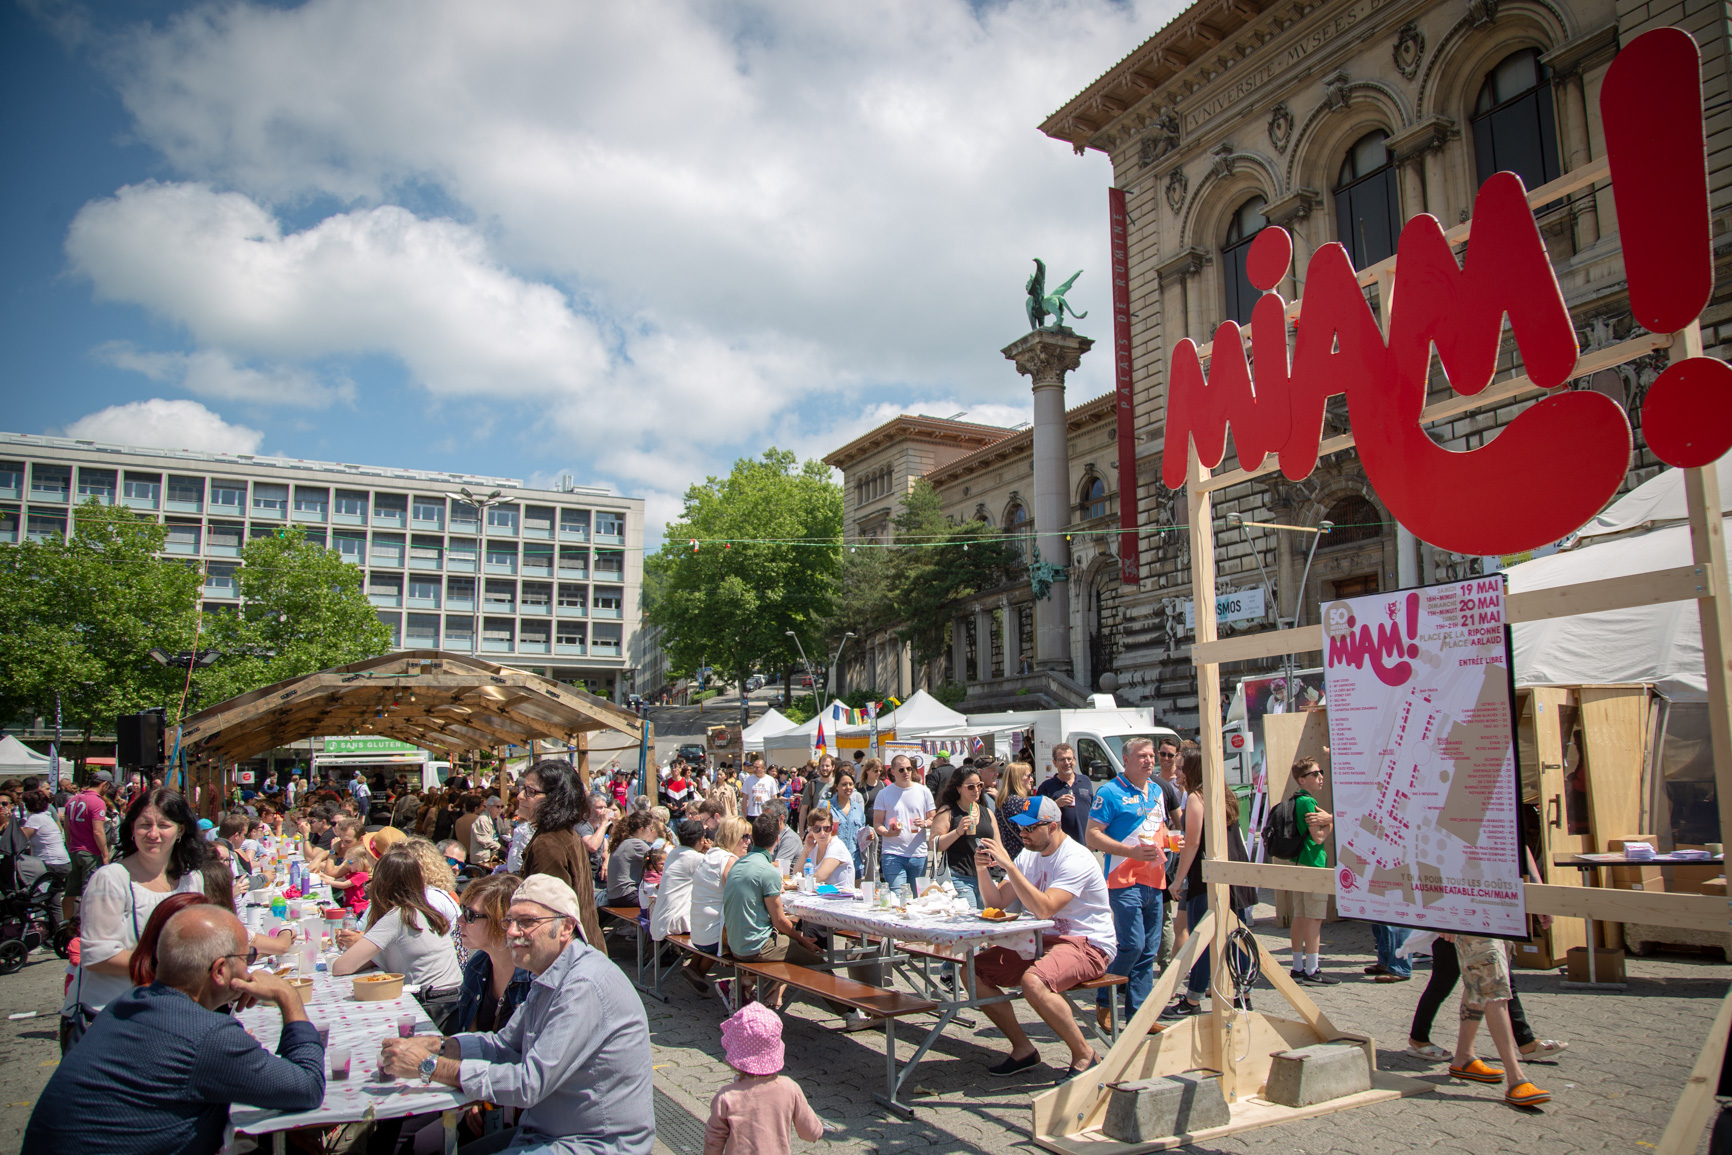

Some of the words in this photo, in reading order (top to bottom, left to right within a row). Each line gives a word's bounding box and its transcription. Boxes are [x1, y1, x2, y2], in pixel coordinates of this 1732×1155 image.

[1113, 212, 1125, 287] RUMINE
[1116, 300, 1127, 323] DE
[1118, 338, 1130, 410] PALAIS
[1460, 583, 1473, 597] 19
[1476, 579, 1499, 595] MAI
[1215, 600, 1242, 616] SMOS
[1428, 600, 1457, 609] DIMANCHE
[1459, 598, 1476, 612] 20
[1477, 595, 1500, 609] MAI
[1329, 607, 1349, 625] 50
[1461, 614, 1475, 627] 21
[1478, 610, 1501, 625] MAI
[1419, 633, 1442, 642] PLACE
[1443, 631, 1453, 640] DE
[1455, 630, 1465, 639] LA
[1468, 626, 1502, 637] RIPONNE
[1436, 622, 1458, 630] 11H-21H
[1444, 638, 1469, 648] PLACE
[1470, 635, 1502, 647] ARLAUD
[1459, 655, 1483, 666] ENTRÉE
[1485, 656, 1503, 665] LIBRE
[340, 741, 364, 749] SANS
[1122, 794, 1140, 806] Sail
[69, 800, 87, 822] 12
[1424, 875, 1443, 884] POUR
[1446, 877, 1466, 885] TOUS
[1467, 879, 1482, 887] LES
[1484, 878, 1513, 890] GOÛTS
[1410, 883, 1519, 900] LAUSANNEATABLE.CH/MIAM
